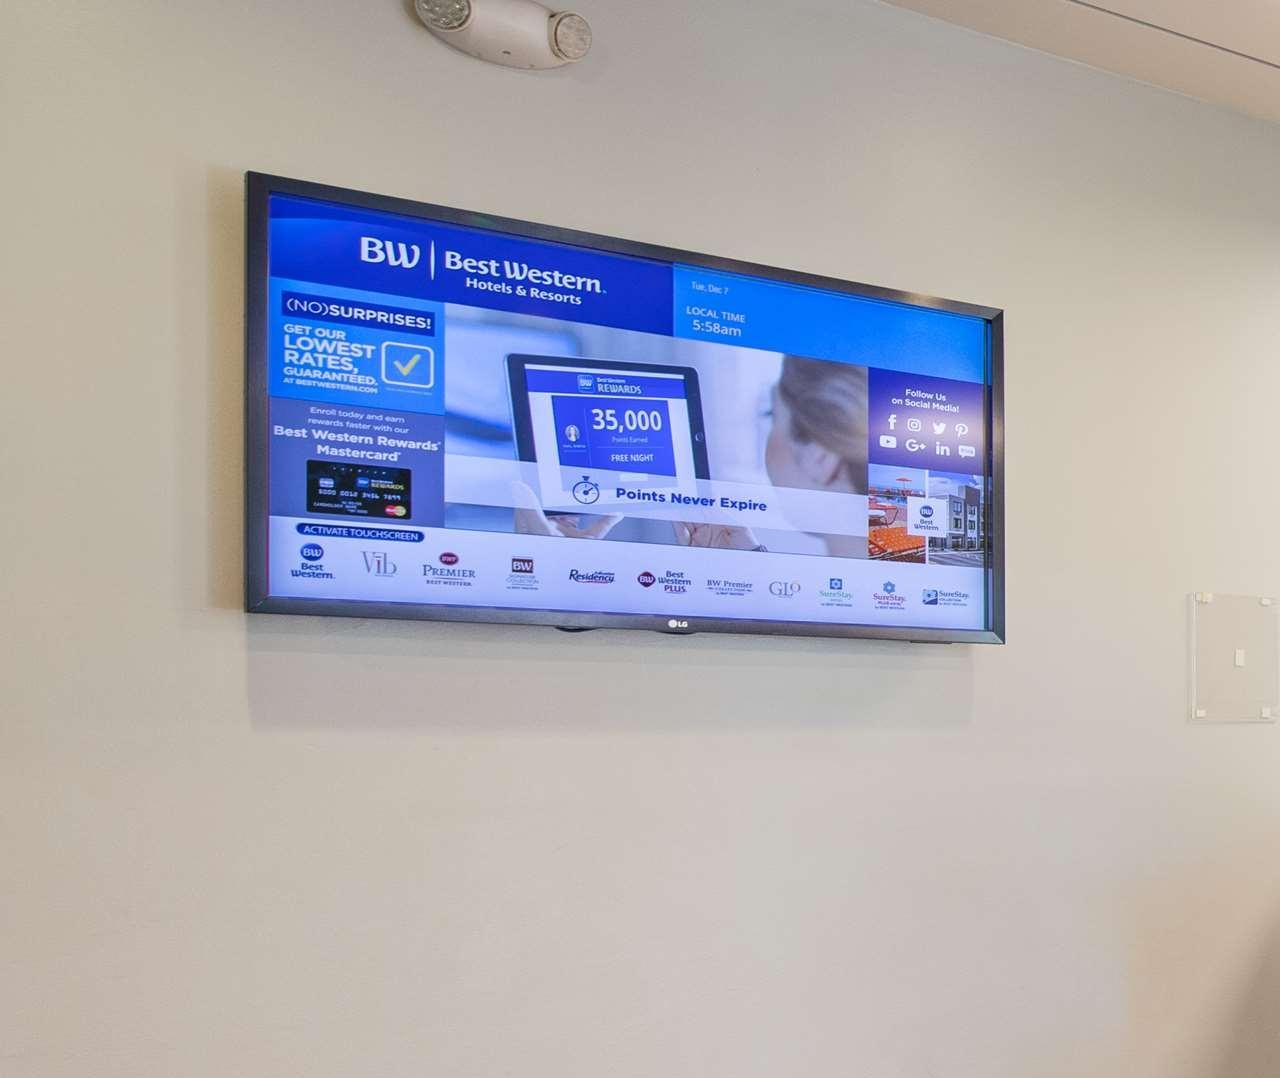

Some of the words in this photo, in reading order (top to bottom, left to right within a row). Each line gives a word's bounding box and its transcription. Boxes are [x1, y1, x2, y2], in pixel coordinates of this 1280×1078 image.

[360, 236, 421, 269] BW
[444, 250, 500, 277] Best
[503, 260, 602, 293] Western
[466, 277, 512, 294] Hotels
[515, 285, 527, 297] &
[530, 288, 582, 305] Resorts
[708, 283, 721, 294] Dec
[686, 305, 719, 319] LOCAL
[721, 311, 746, 323] TIME
[283, 323, 312, 335] GET
[314, 327, 347, 340] OUR
[692, 319, 742, 336] 5:58am
[284, 334, 377, 359] LOWEST
[284, 349, 359, 375] RATES,
[283, 366, 379, 386] GUARANTEED.
[597, 384, 642, 394] REWARDS
[905, 388, 934, 399] Follow
[936, 393, 946, 402] Us
[904, 398, 930, 409] Social
[932, 402, 960, 413] Media!
[309, 406, 337, 416] Enroll
[338, 409, 364, 420] today
[366, 412, 384, 421] and
[385, 415, 406, 423] earn
[591, 408, 662, 432] 35,000
[308, 417, 344, 427] rewards
[345, 420, 371, 431] faster
[372, 423, 393, 433] with
[393, 426, 410, 434] our
[273, 425, 308, 439] Best
[311, 428, 374, 446] Western
[316, 444, 399, 462] Mastercard
[611, 453, 629, 462] FREE
[630, 453, 654, 463] NIGHT
[615, 487, 666, 503] Points
[670, 492, 716, 507] Never
[720, 497, 768, 511] Expire
[303, 525, 349, 536] ACTIVATE
[349, 528, 420, 541] TOUCHSCREEN
[914, 523, 939, 531] Western
[303, 547, 322, 558] BW
[301, 562, 324, 571] Best
[423, 564, 476, 578] PREMIER
[512, 561, 532, 571] BW
[291, 569, 334, 580] Western
[569, 569, 615, 584] Residency
[658, 577, 692, 587] Western
[666, 570, 684, 579] Best
[664, 584, 686, 593] PLUS
[723, 580, 753, 588] Premier
[872, 592, 905, 603] SureStay
[677, 620, 688, 628] LG
